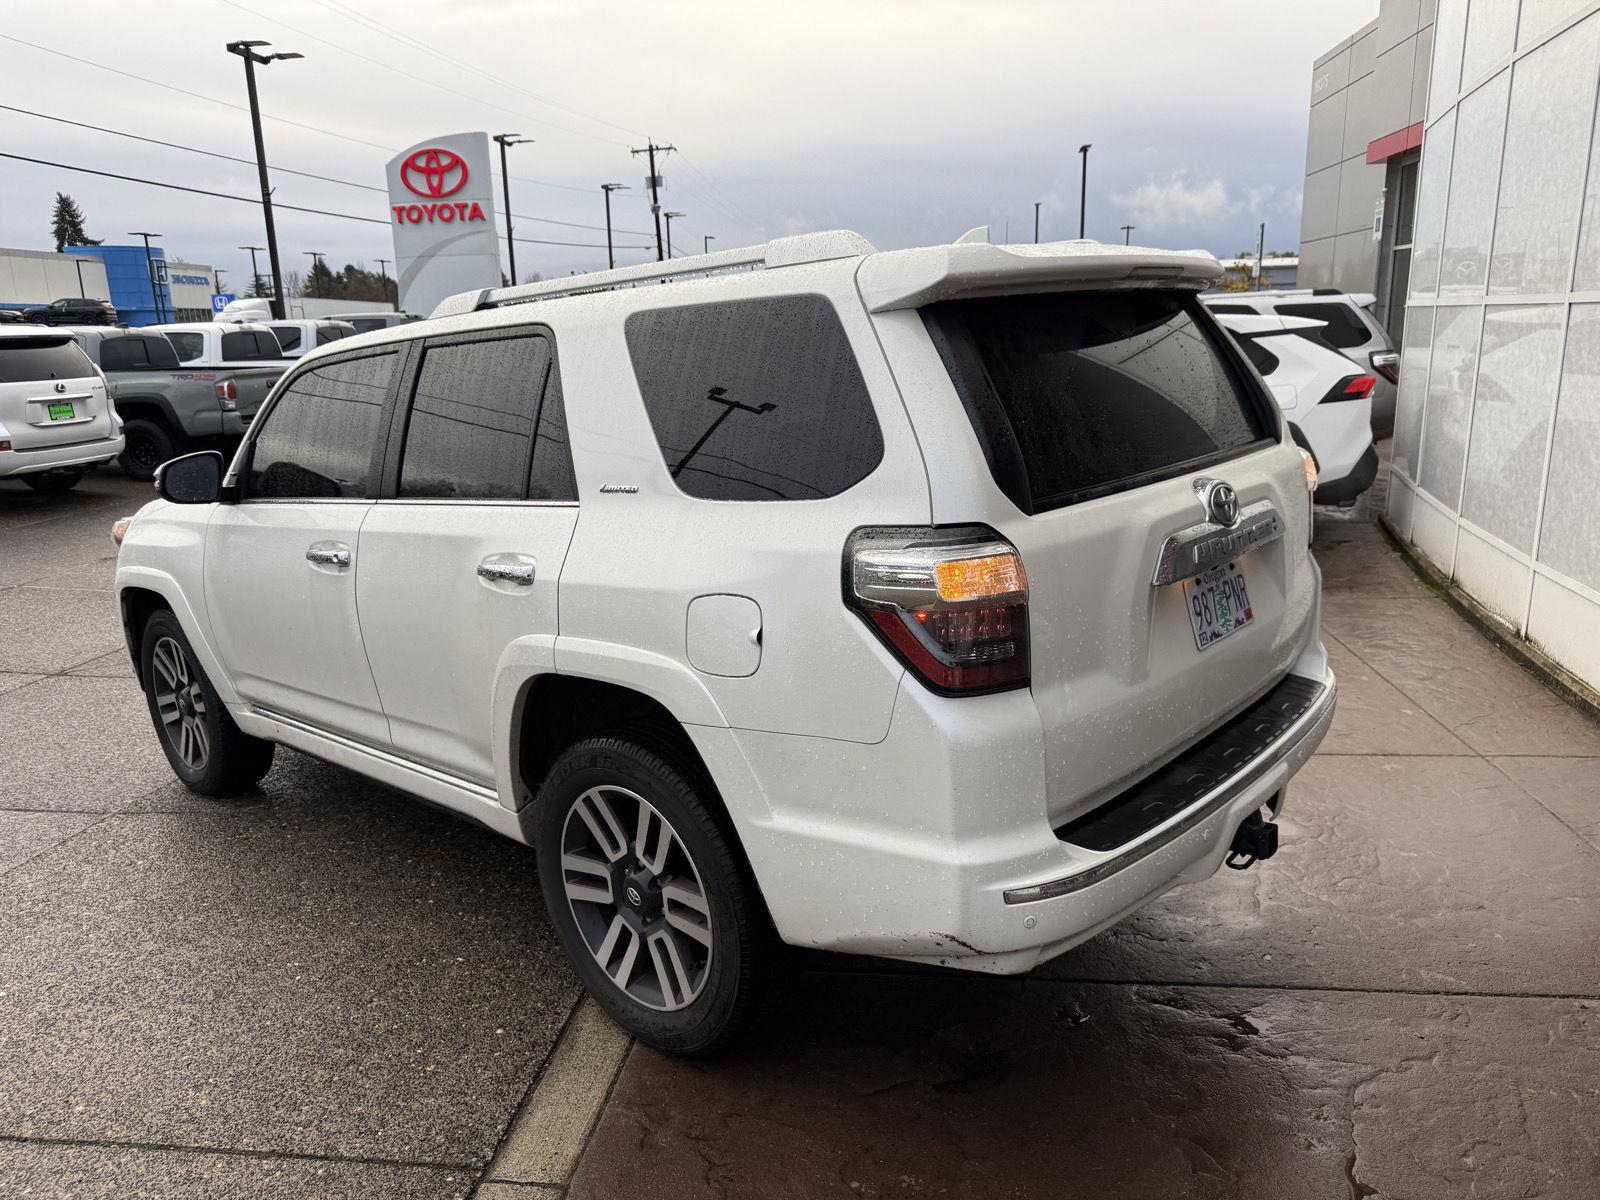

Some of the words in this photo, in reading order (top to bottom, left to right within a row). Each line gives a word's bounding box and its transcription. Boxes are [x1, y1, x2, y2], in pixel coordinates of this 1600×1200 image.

[392, 201, 486, 224] TOYOTA
[171, 274, 210, 286] HONDA
[1203, 567, 1226, 584] Oregon
[1192, 586, 1219, 630] 987
[1222, 574, 1250, 616] PNR
